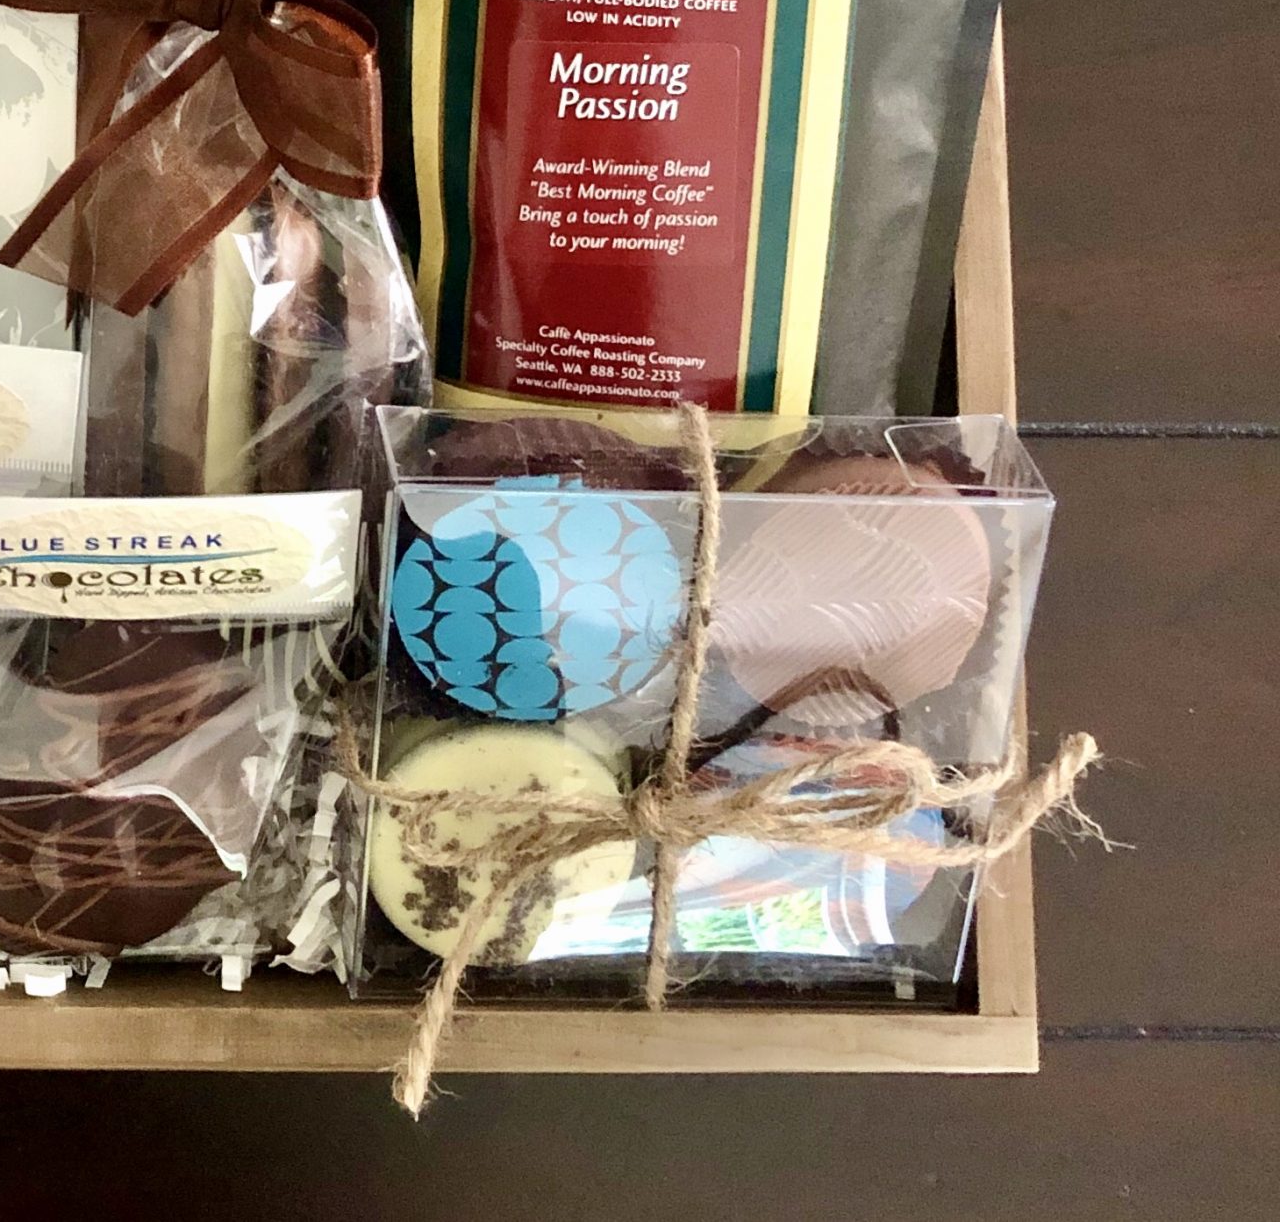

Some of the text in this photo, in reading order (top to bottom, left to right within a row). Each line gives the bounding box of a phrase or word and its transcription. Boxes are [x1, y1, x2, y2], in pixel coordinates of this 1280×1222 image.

[566, 10, 681, 28] LOW IN ACIDITY
[549, 52, 690, 95] Morning
[557, 88, 679, 121] Passion
[532, 157, 711, 180] Award-Winning Blend
[530, 180, 714, 206] "Best Morning Coffee"
[519, 205, 718, 229] Bring a touch of passion
[549, 233, 686, 256] to your morning!
[573, 329, 655, 346] Appassionato
[495, 336, 706, 370] Specialty Coffee Roasting Company
[562, 363, 582, 375] WA
[590, 365, 681, 383] 888-502-2333
[516, 376, 680, 399] www.caffeappassionato.com
[84, 533, 222, 551] STREAK
